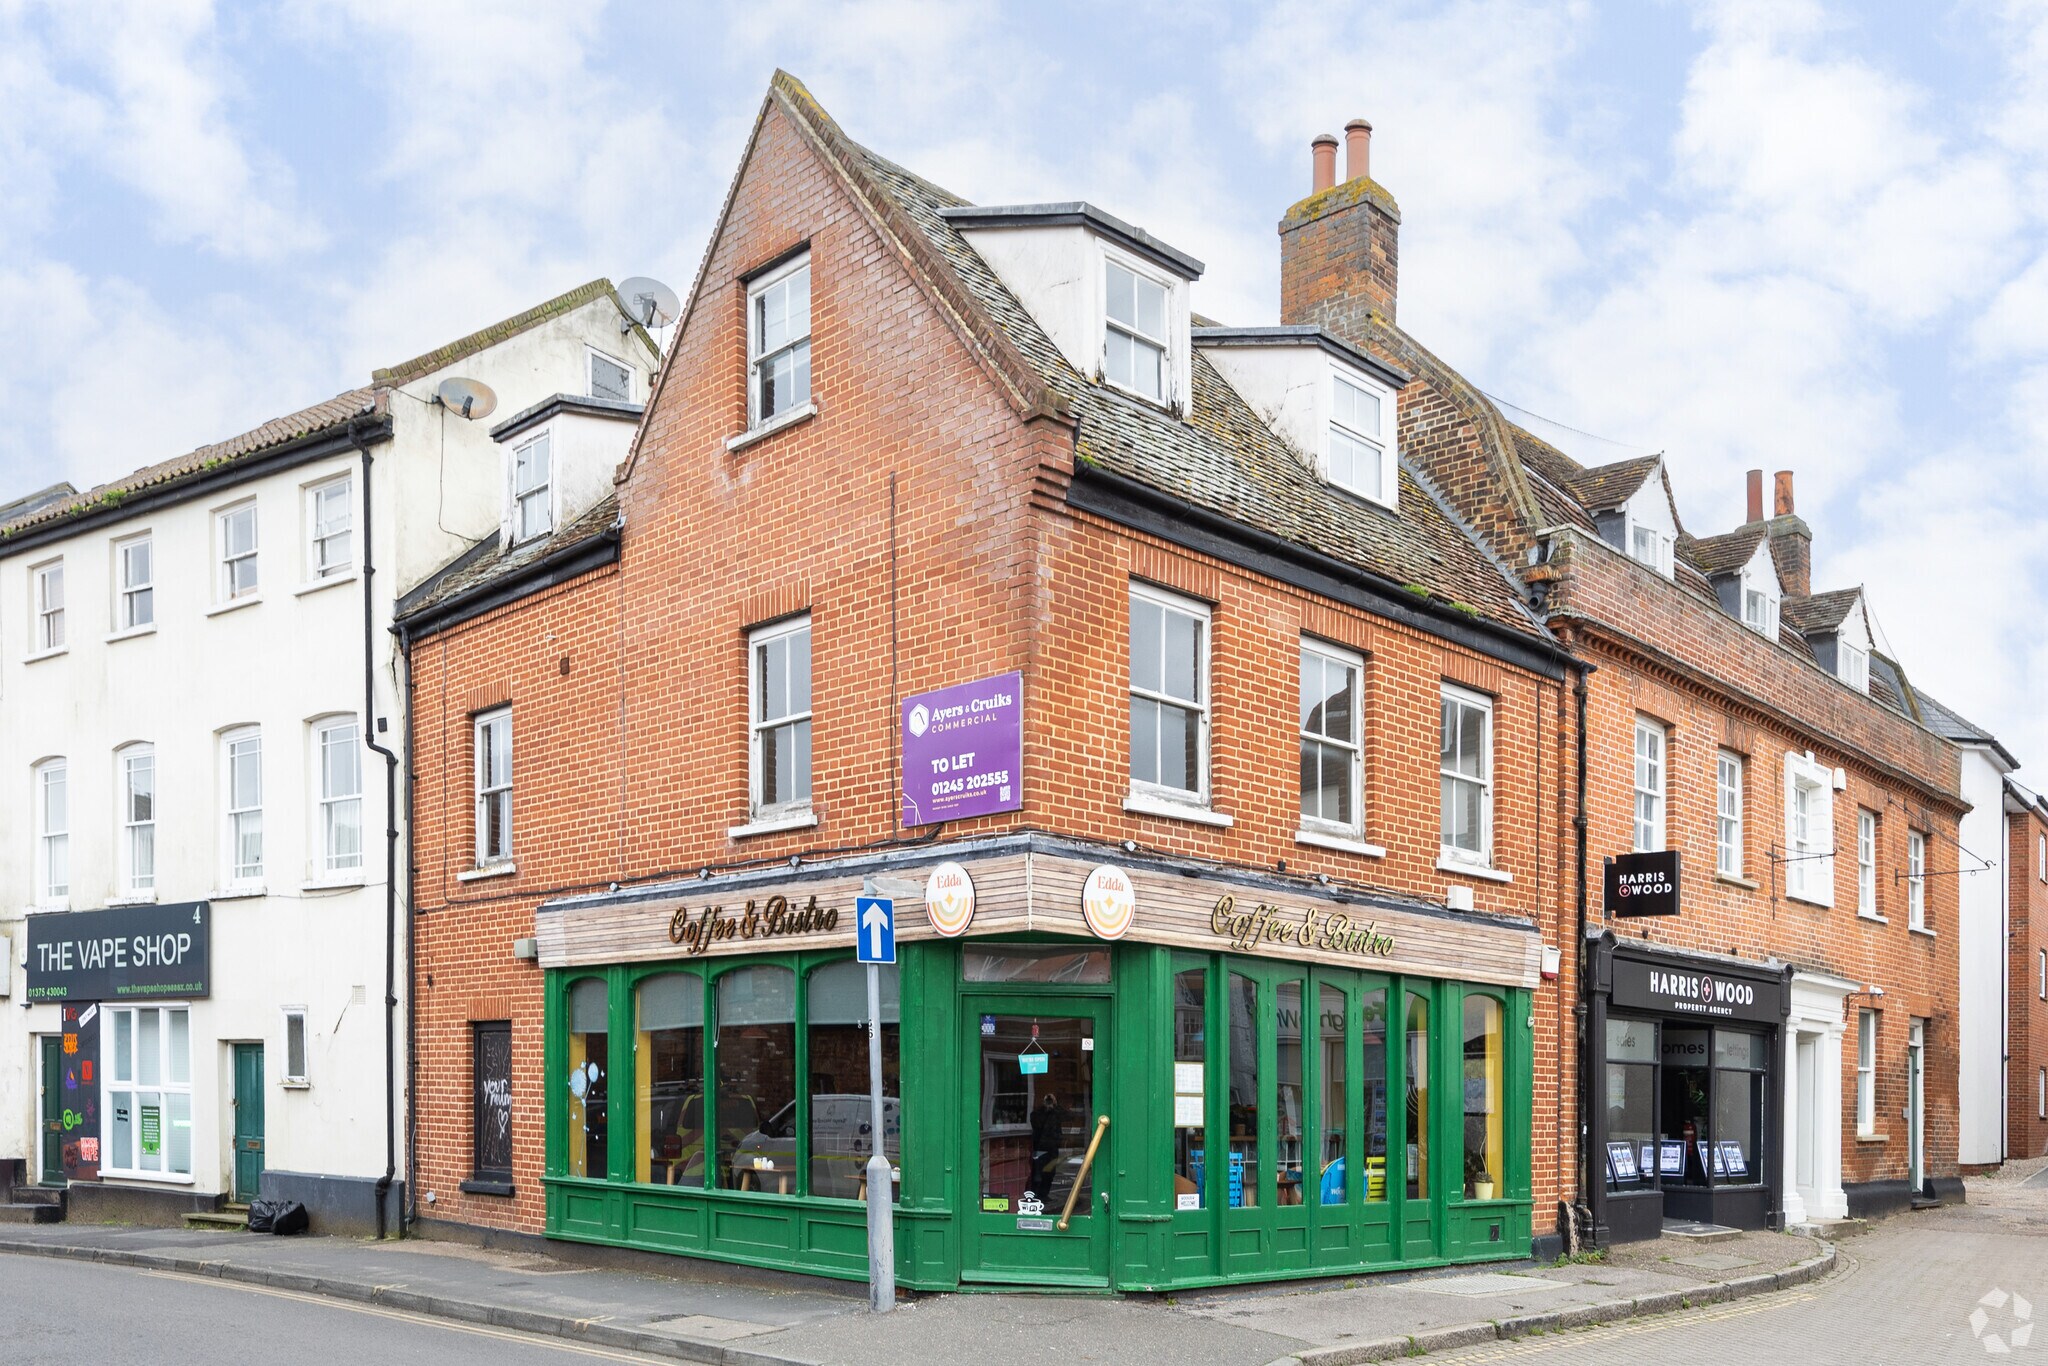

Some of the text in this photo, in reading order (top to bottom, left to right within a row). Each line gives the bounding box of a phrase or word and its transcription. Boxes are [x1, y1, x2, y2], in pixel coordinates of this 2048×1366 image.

[931, 693, 1012, 723] Ayers & Cruiks
[931, 713, 997, 733] COMMERCIAL
[931, 752, 975, 774] TO LET
[931, 770, 1009, 796] 01245 202555
[936, 873, 962, 889] Edda
[1097, 875, 1124, 892] Edda
[1619, 871, 1665, 885] HARRIS
[1631, 883, 1672, 895] WOOD
[192, 905, 201, 924] 4
[668, 895, 839, 954] Coffee & Bistro
[1211, 893, 1395, 956] Coffee & Bistro
[37, 932, 191, 972] THE VAPE SHOP
[28, 987, 45, 998] 01375
[1650, 971, 1754, 1005] HARRIS WOOD
[1674, 1001, 1732, 1015] PROPERTY AGENCY
[1615, 1035, 1636, 1048] sales
[1661, 1043, 1705, 1055] omes
